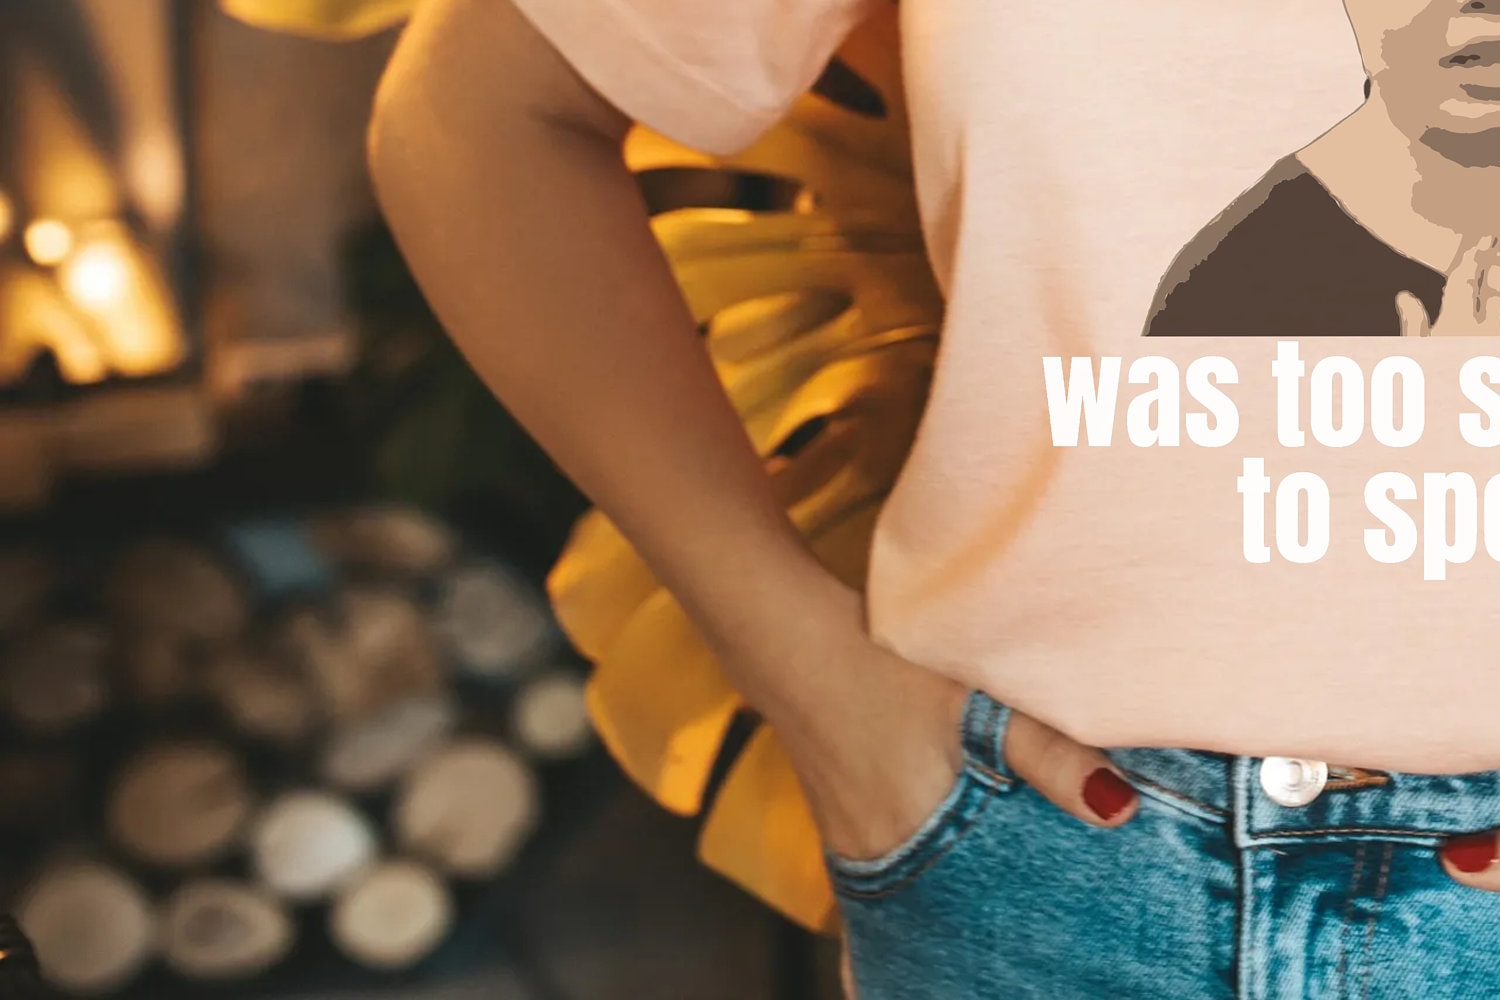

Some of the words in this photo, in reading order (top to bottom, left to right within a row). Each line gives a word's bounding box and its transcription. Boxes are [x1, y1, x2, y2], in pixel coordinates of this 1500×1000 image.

[1042, 356, 1239, 447] was
[1272, 341, 1426, 447] too
[1236, 456, 1330, 563] to
